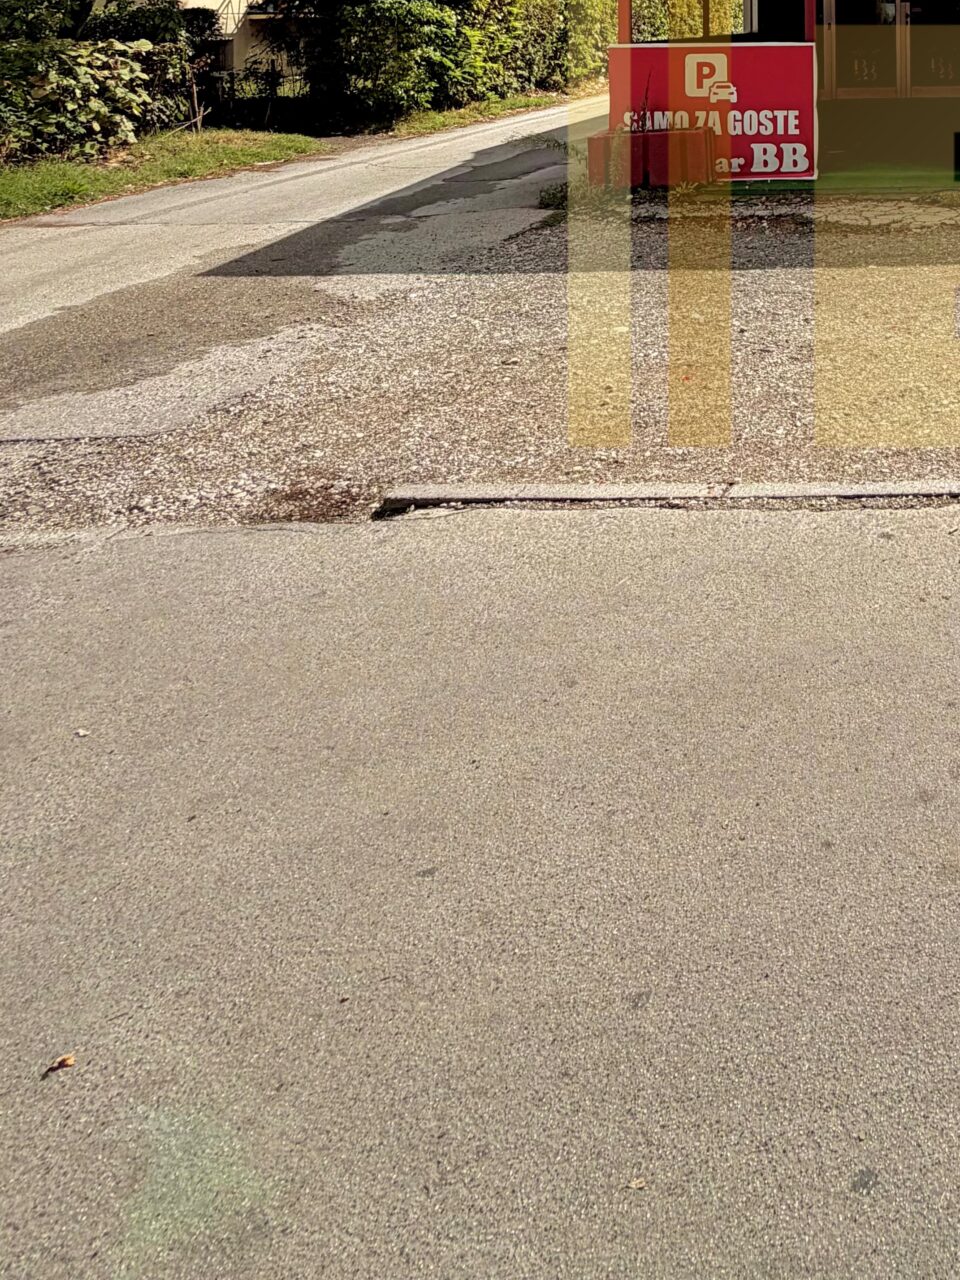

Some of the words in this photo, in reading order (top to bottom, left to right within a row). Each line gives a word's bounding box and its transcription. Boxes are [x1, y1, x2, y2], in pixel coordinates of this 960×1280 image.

[696, 61, 716, 89] P
[695, 111, 722, 135] ZA
[727, 110, 800, 136] GOSTE
[714, 157, 745, 173] ar
[750, 143, 809, 173] BB
